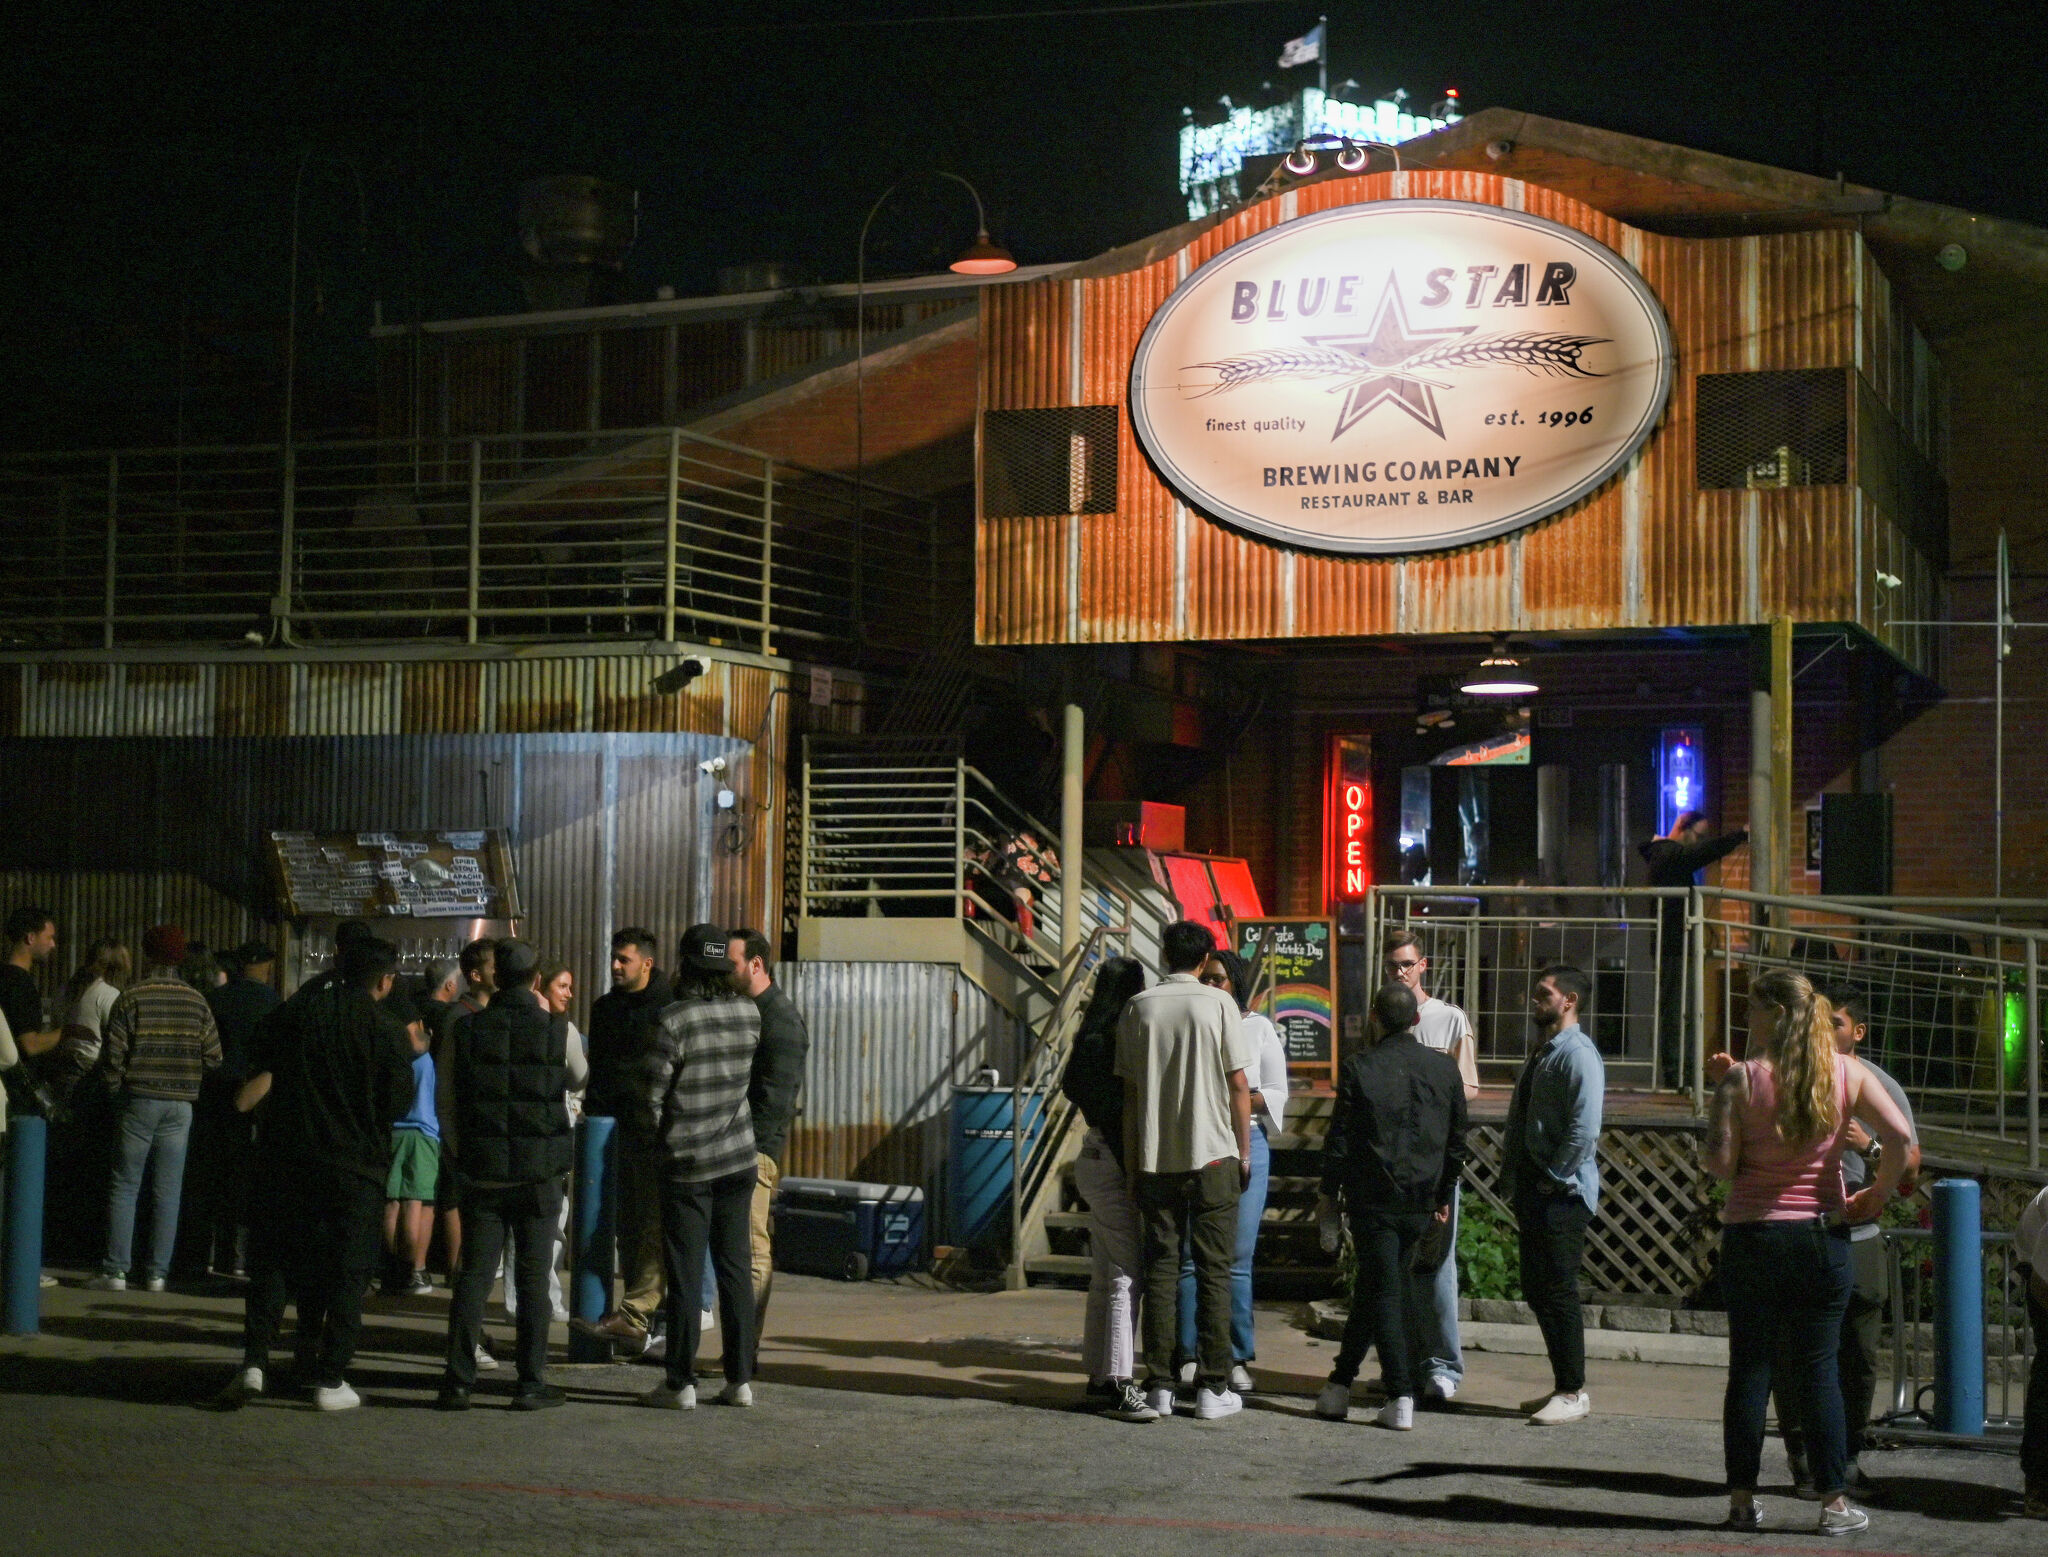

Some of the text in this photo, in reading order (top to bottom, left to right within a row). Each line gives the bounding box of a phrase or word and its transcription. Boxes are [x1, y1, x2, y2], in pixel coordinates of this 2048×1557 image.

[1231, 261, 1578, 323] BLUE STAR
[1205, 417, 1306, 434] finest quality
[1484, 405, 1594, 428] est. 1996
[1262, 456, 1522, 488] BREWING COMPANY
[1300, 489, 1474, 510] RESTAURANT & BAR
[1346, 785, 1365, 894] OPEN
[1306, 943, 1323, 960] Day
